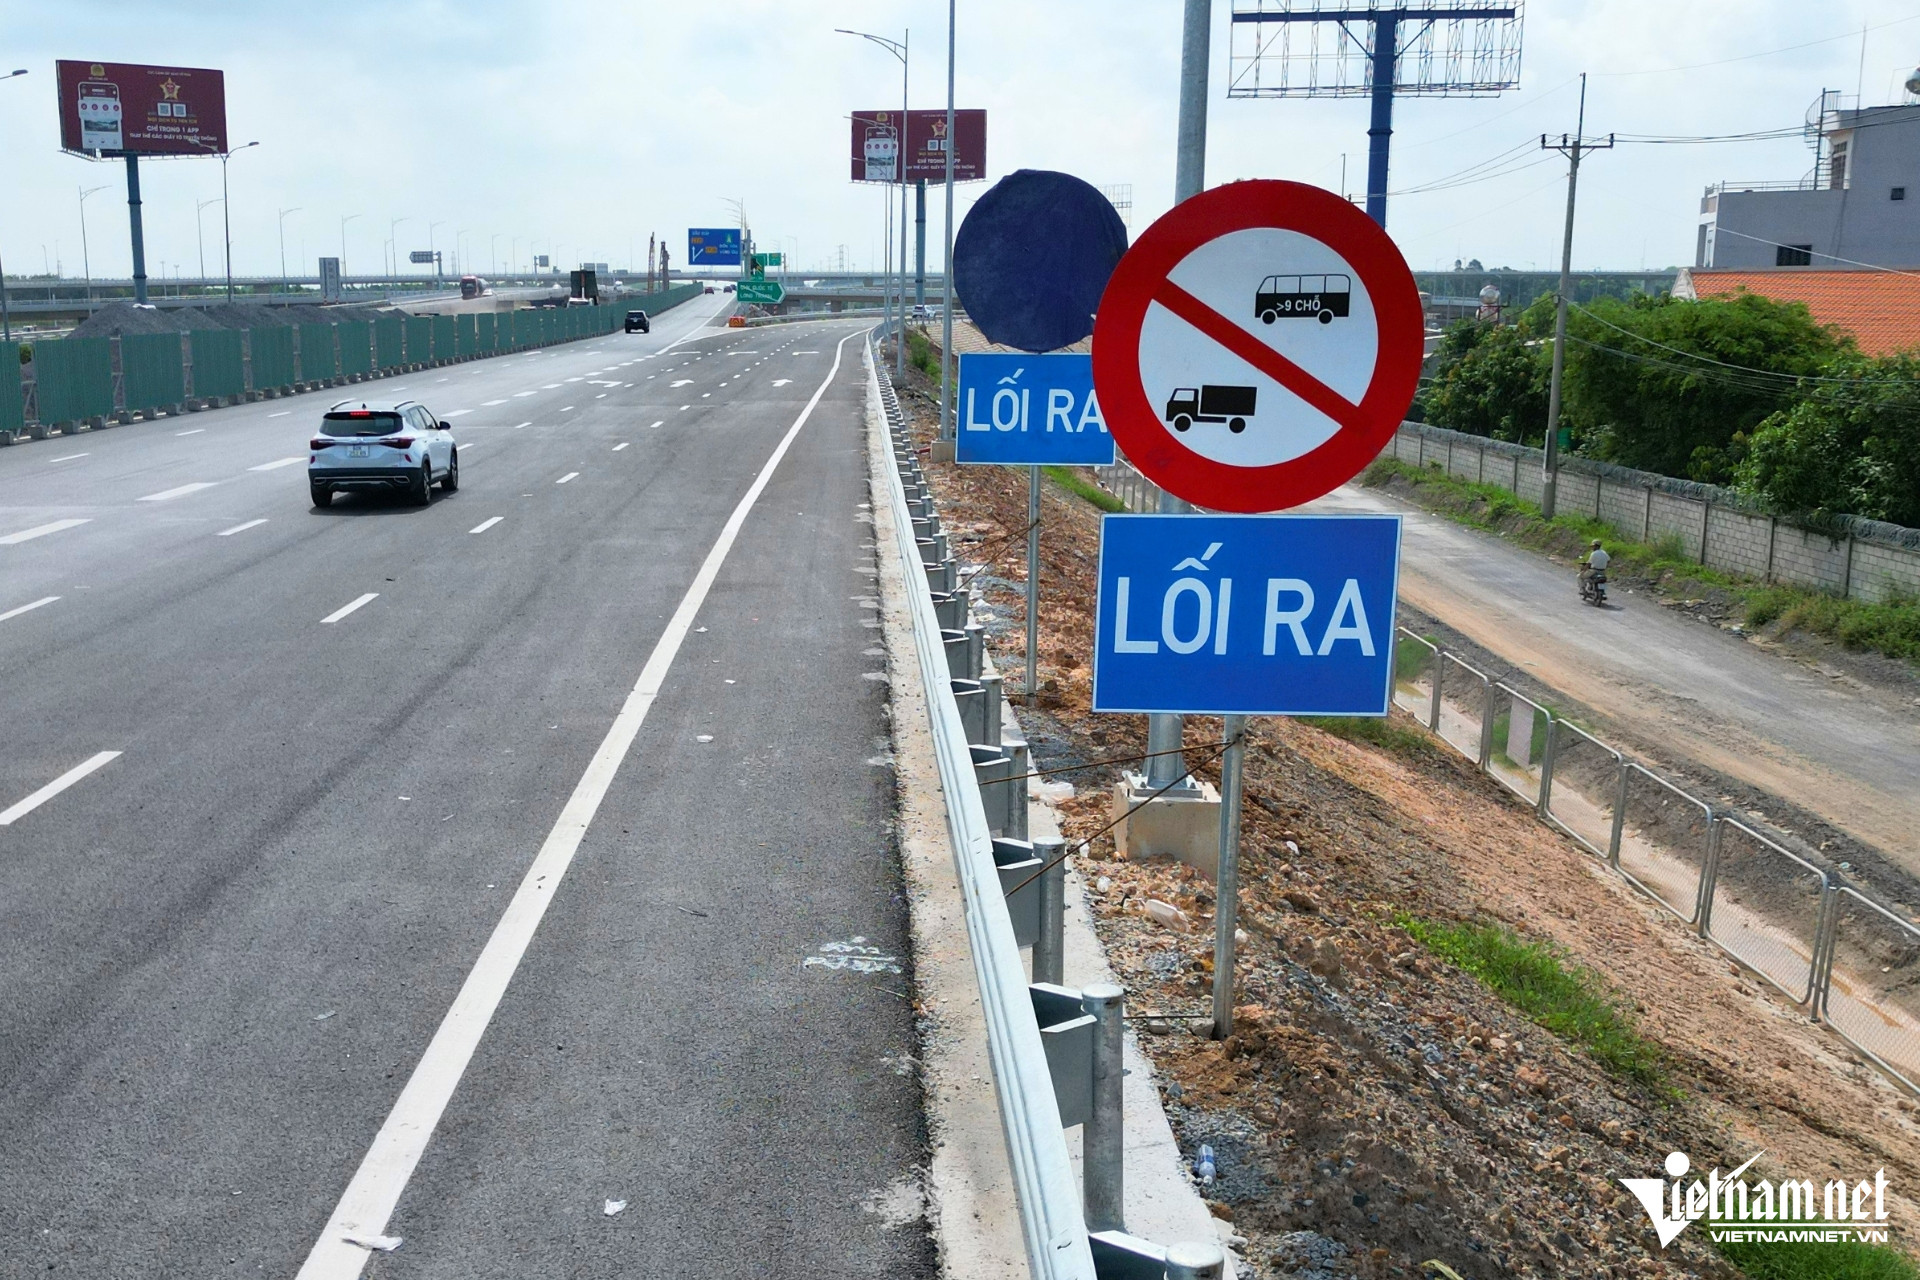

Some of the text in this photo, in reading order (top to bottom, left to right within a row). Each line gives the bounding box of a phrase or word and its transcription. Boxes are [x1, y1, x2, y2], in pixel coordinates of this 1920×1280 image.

[1295, 294, 1321, 311] CHỖ
[966, 368, 1108, 433] LỐI RA
[1114, 542, 1376, 657] LỐI RA
